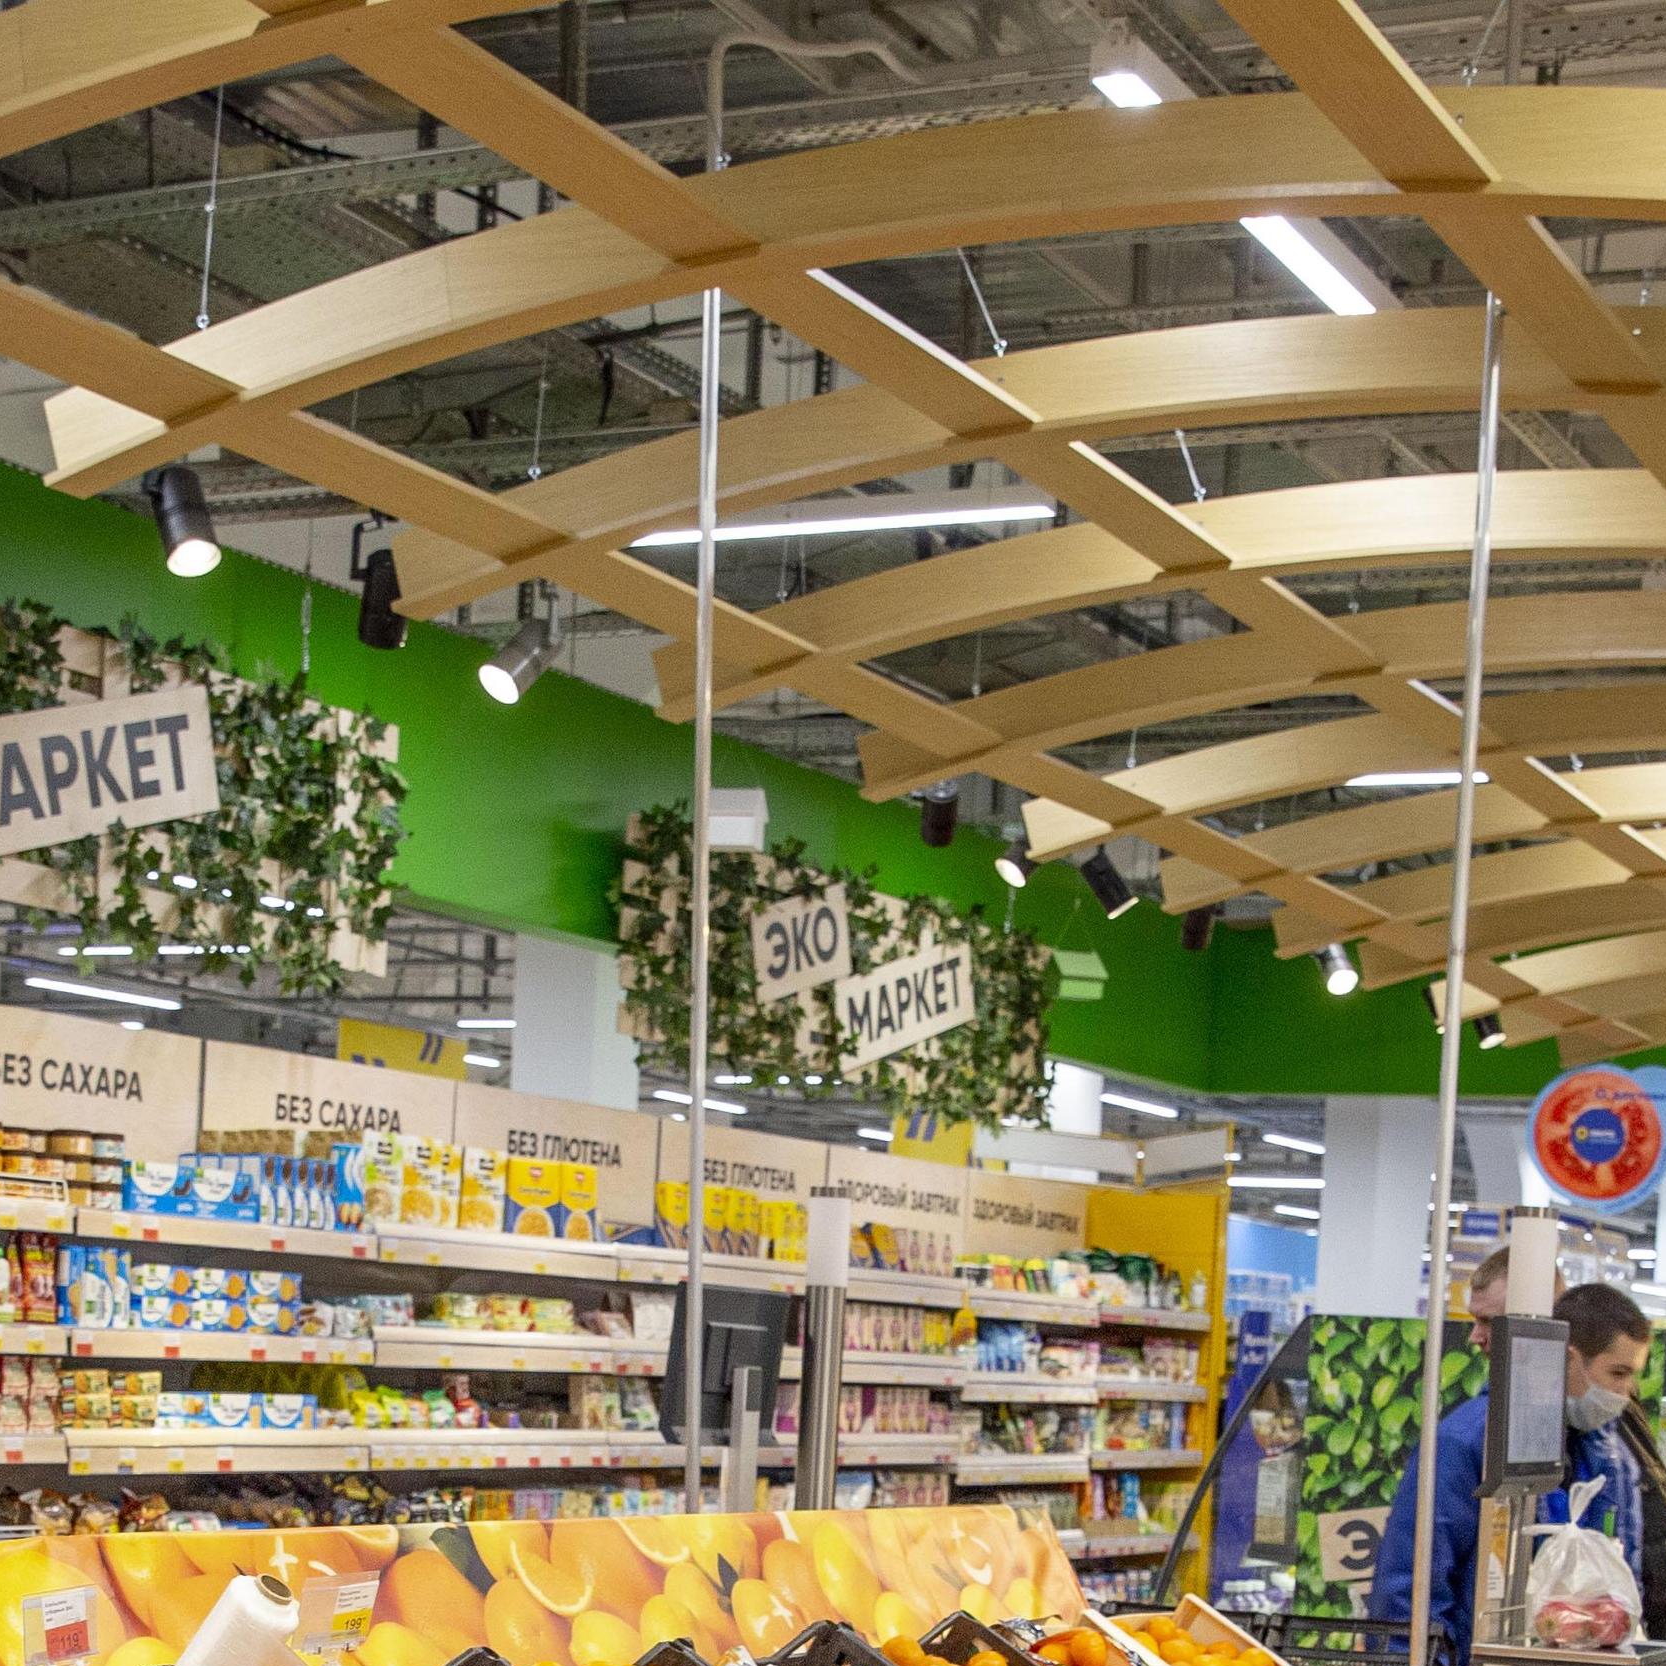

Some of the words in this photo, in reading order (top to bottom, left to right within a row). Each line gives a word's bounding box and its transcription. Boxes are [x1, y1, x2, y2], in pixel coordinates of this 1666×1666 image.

[764, 906, 840, 980] ЭКО
[847, 956, 961, 1043] МАРКЕТ
[41, 1058, 143, 1102] САХАРА
[276, 1093, 312, 1123] БЕЗ
[319, 1100, 401, 1135] САХАРА
[508, 1129, 537, 1157] БЕЗ
[543, 1134, 622, 1168] ГЛЮТЕНА
[704, 1158, 727, 1180] БЕЗ
[731, 1163, 796, 1192] ГЛЮТЕНА
[910, 1188, 960, 1217] ЗАВТРАК
